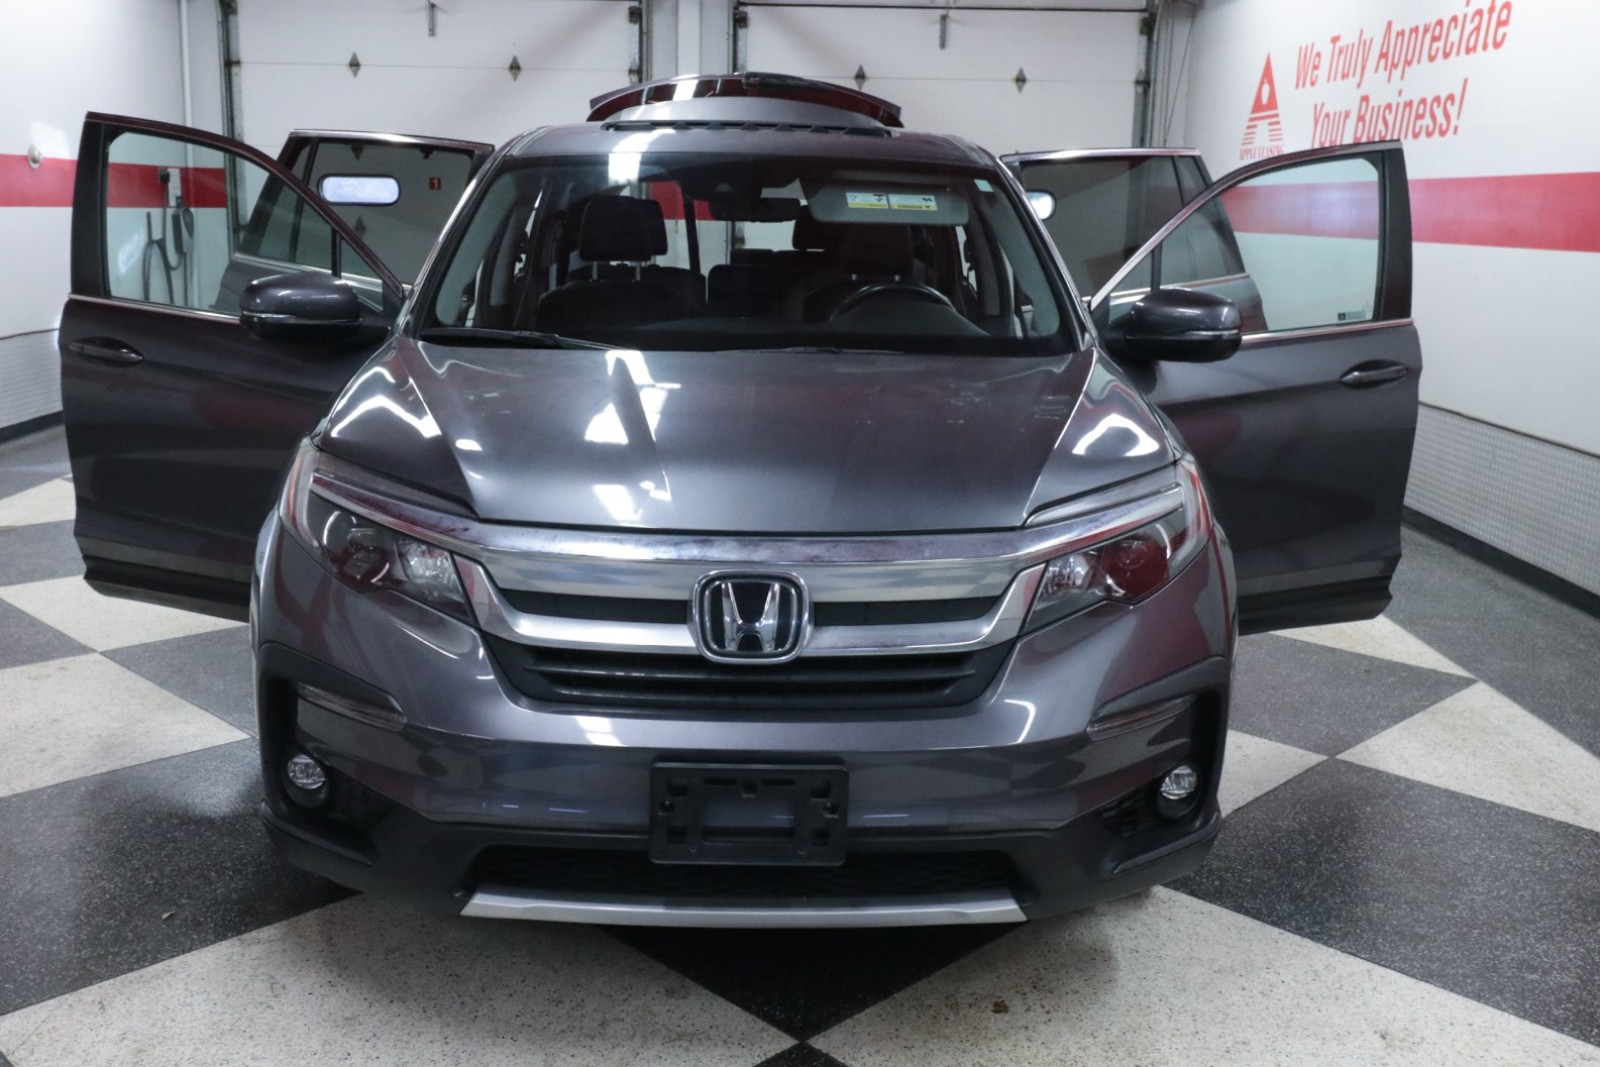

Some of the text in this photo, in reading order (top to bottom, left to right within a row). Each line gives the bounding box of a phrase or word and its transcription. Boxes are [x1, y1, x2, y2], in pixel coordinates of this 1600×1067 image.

[1295, 0, 1513, 90] We Truly Appreciate
[1311, 77, 1467, 148] Your Business!
